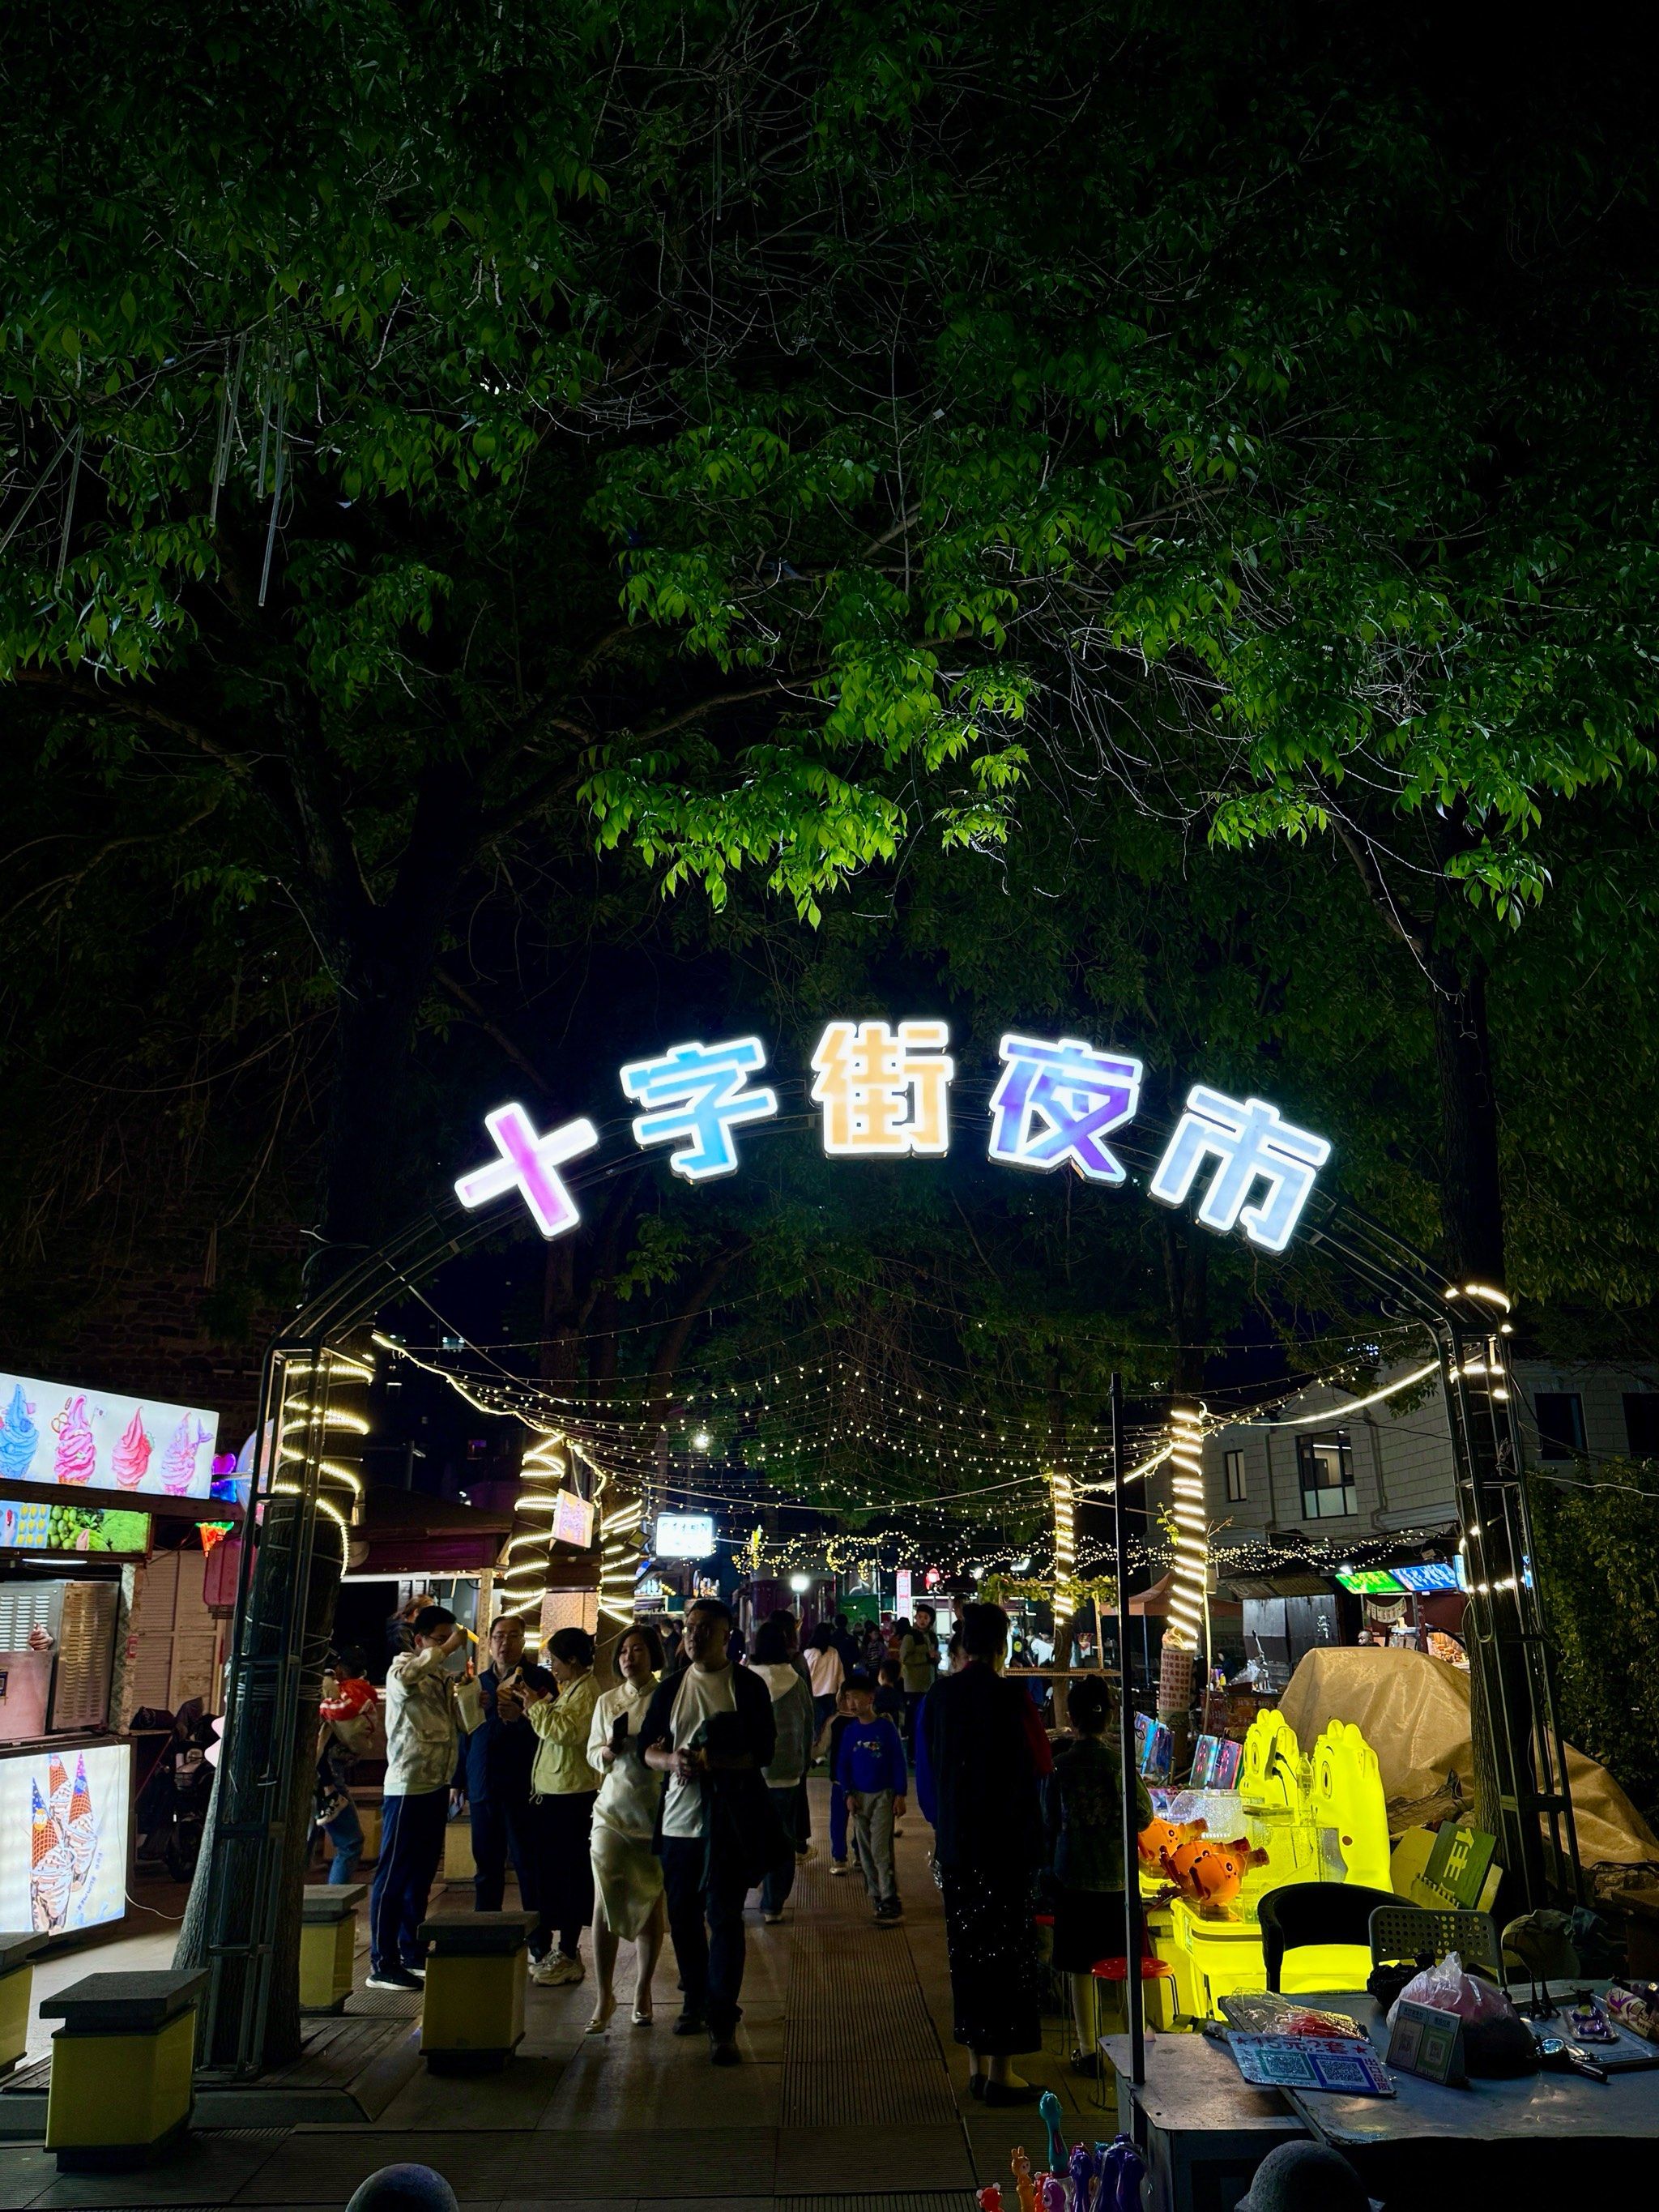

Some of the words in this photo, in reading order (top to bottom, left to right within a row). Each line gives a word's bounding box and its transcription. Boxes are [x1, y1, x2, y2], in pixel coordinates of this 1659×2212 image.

[454, 1021, 1332, 1252] 十字街夜市
